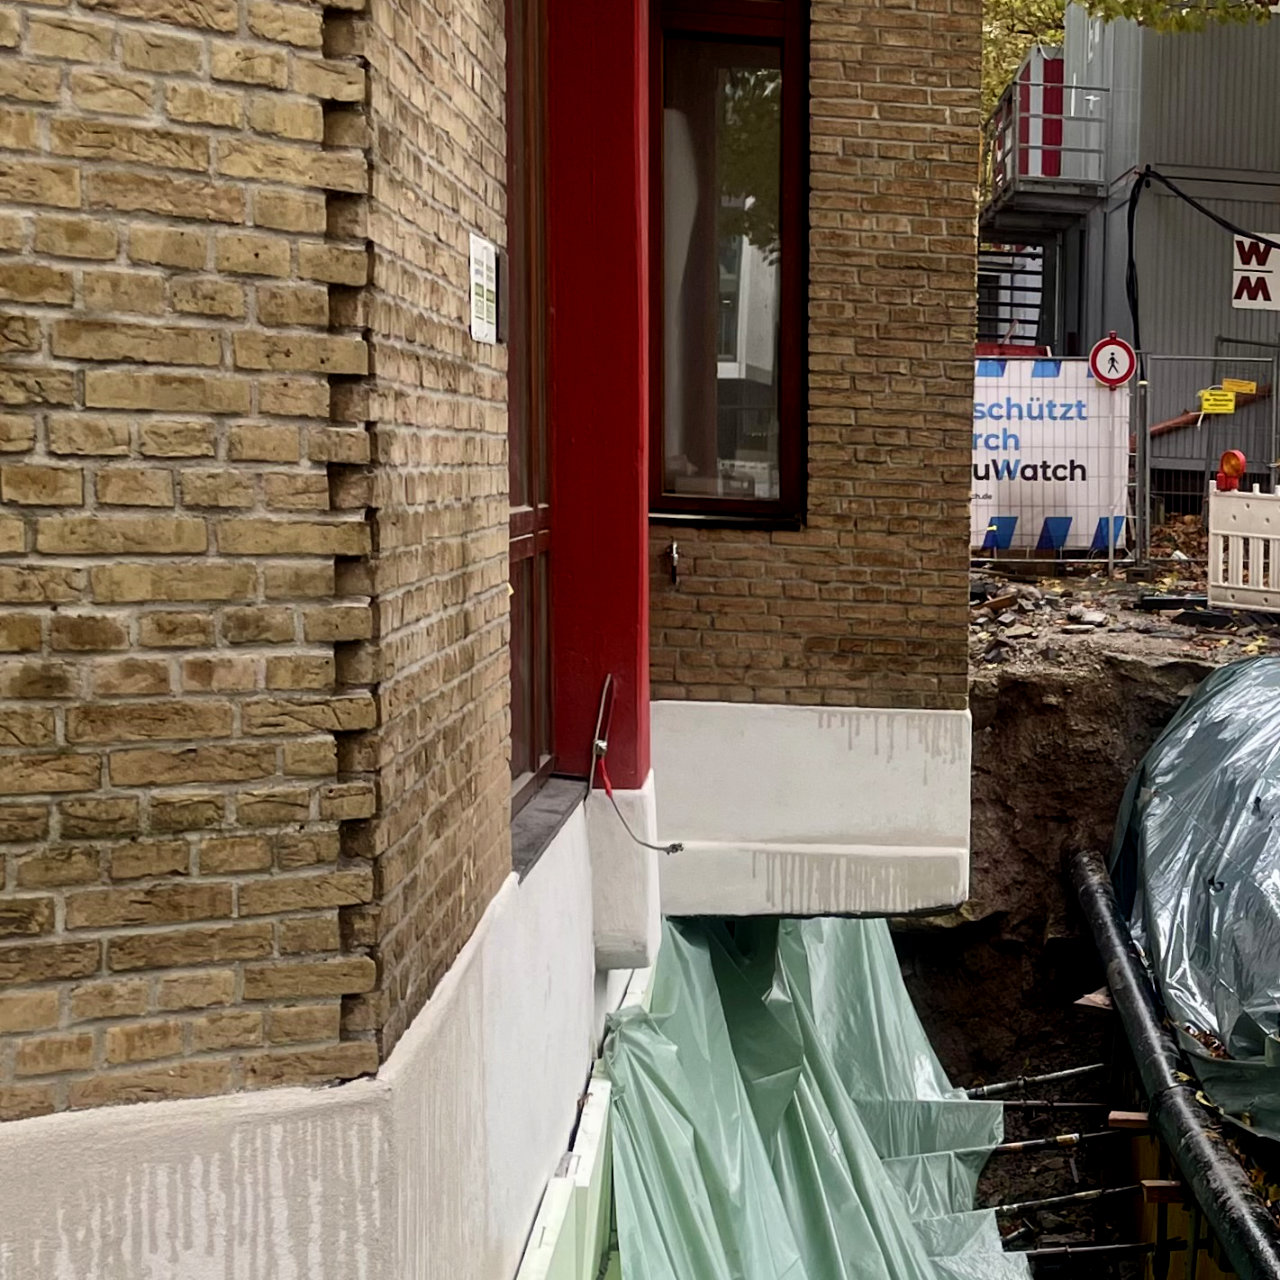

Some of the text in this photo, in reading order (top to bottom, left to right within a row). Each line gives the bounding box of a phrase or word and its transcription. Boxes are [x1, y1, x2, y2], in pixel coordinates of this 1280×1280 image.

[973, 397, 1088, 421] schützt
[973, 428, 1020, 451] rch
[973, 459, 1087, 482] uWatch
